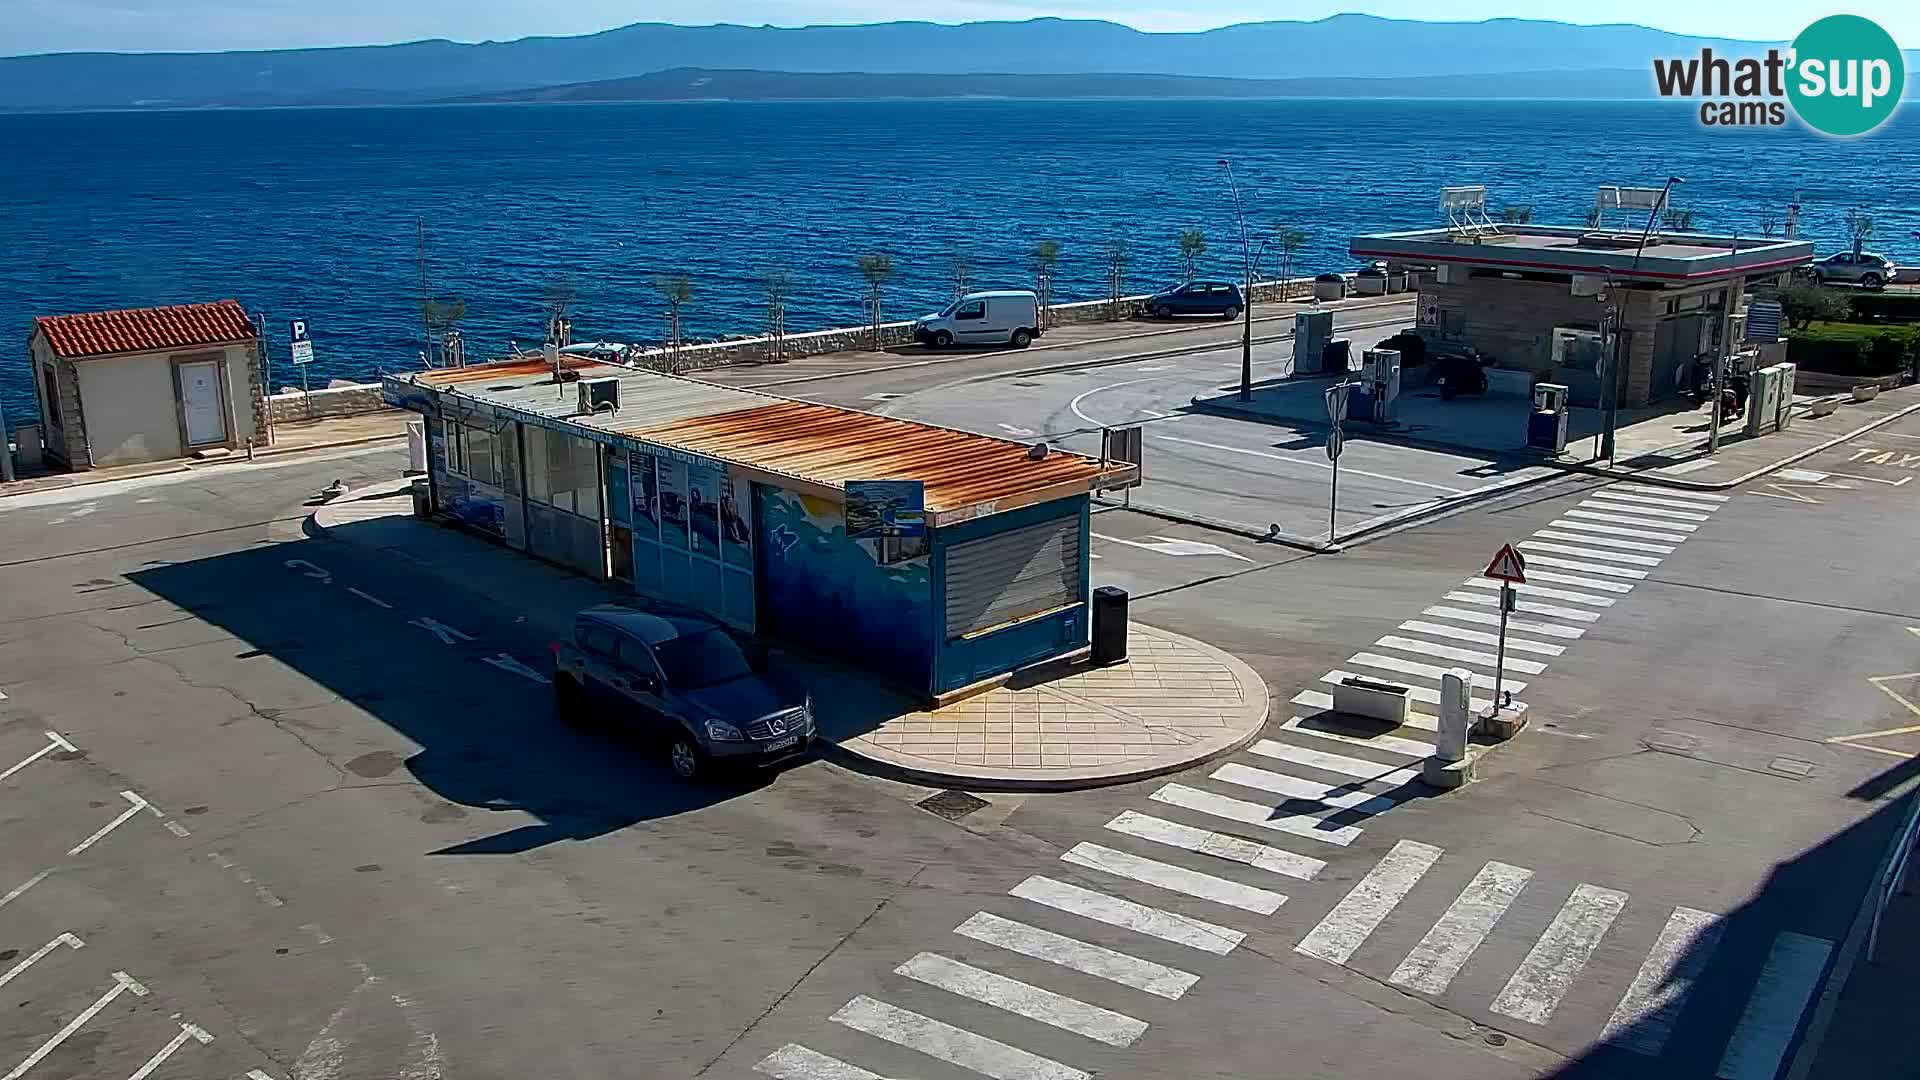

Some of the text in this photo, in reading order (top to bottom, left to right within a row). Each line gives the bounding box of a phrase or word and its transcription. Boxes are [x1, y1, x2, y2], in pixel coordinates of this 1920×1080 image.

[293, 321, 305, 340] P
[638, 443, 669, 458] STATION
[671, 451, 697, 466] TICKET
[697, 457, 726, 472] OFFICE
